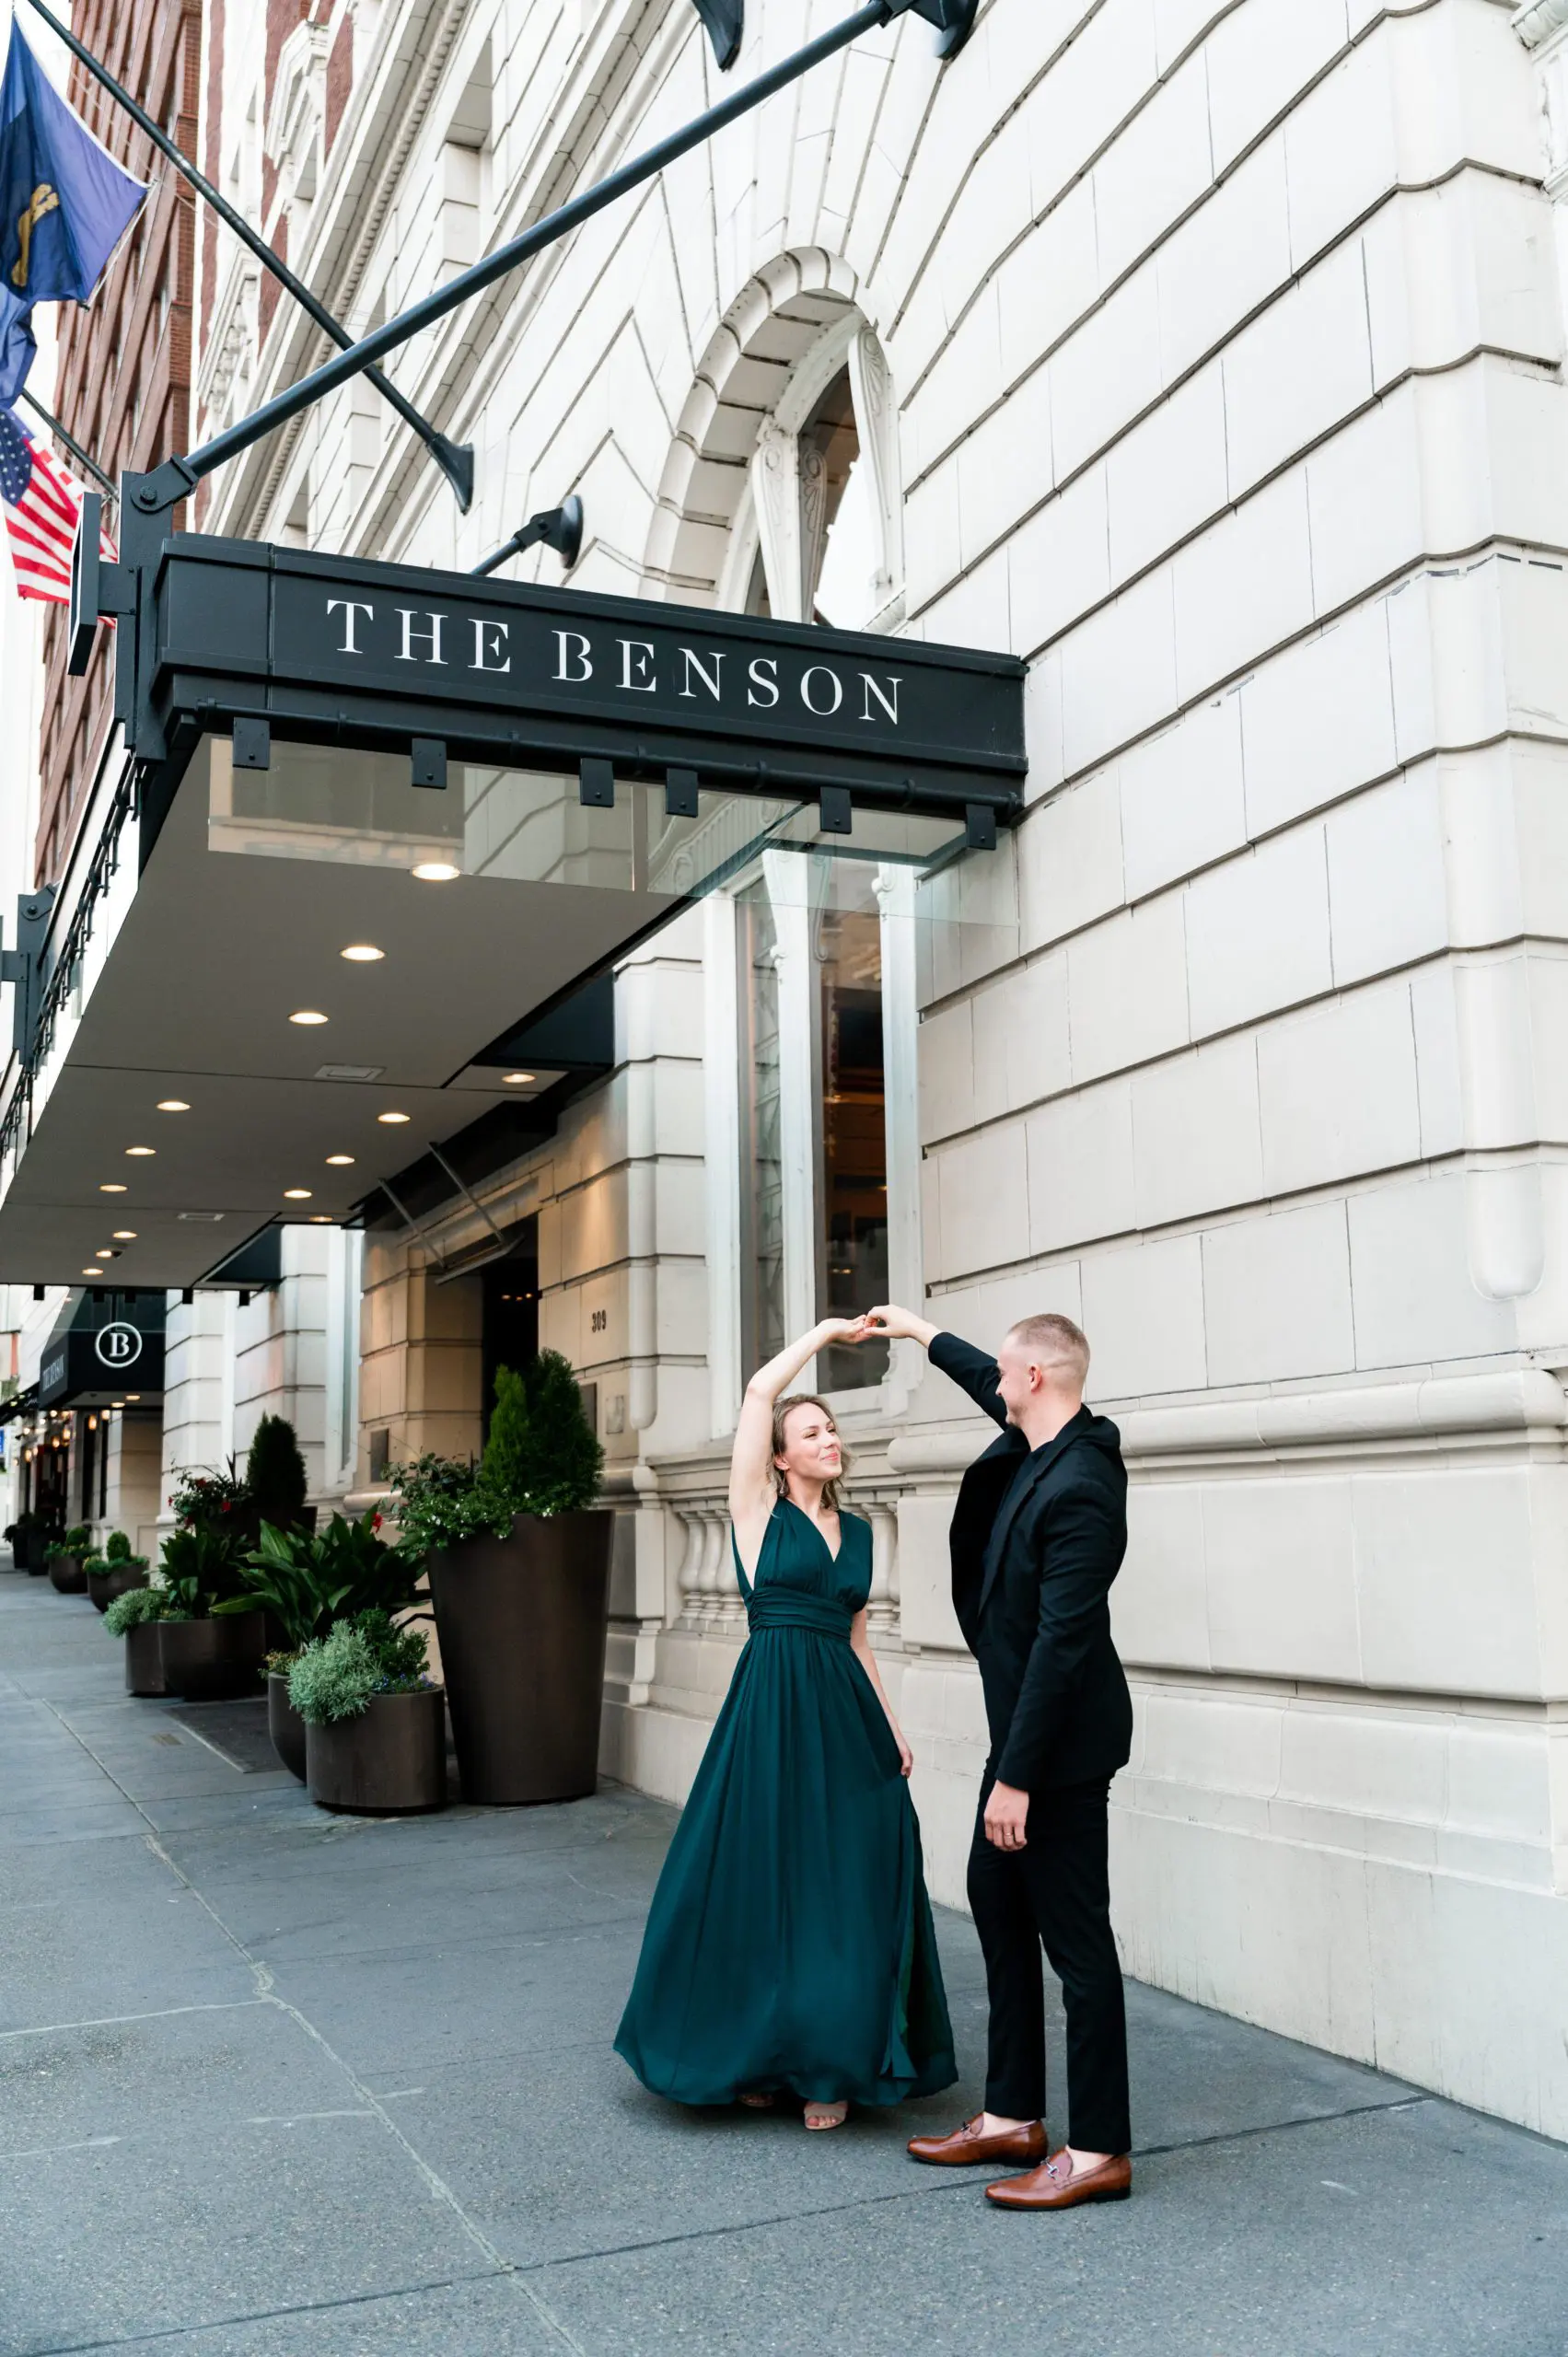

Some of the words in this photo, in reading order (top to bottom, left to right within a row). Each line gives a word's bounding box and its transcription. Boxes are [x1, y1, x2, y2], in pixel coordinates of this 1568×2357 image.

[326, 598, 511, 673] THE
[552, 630, 903, 725] BENSON
[591, 1309, 607, 1333] 309
[110, 1332, 130, 1357] B
